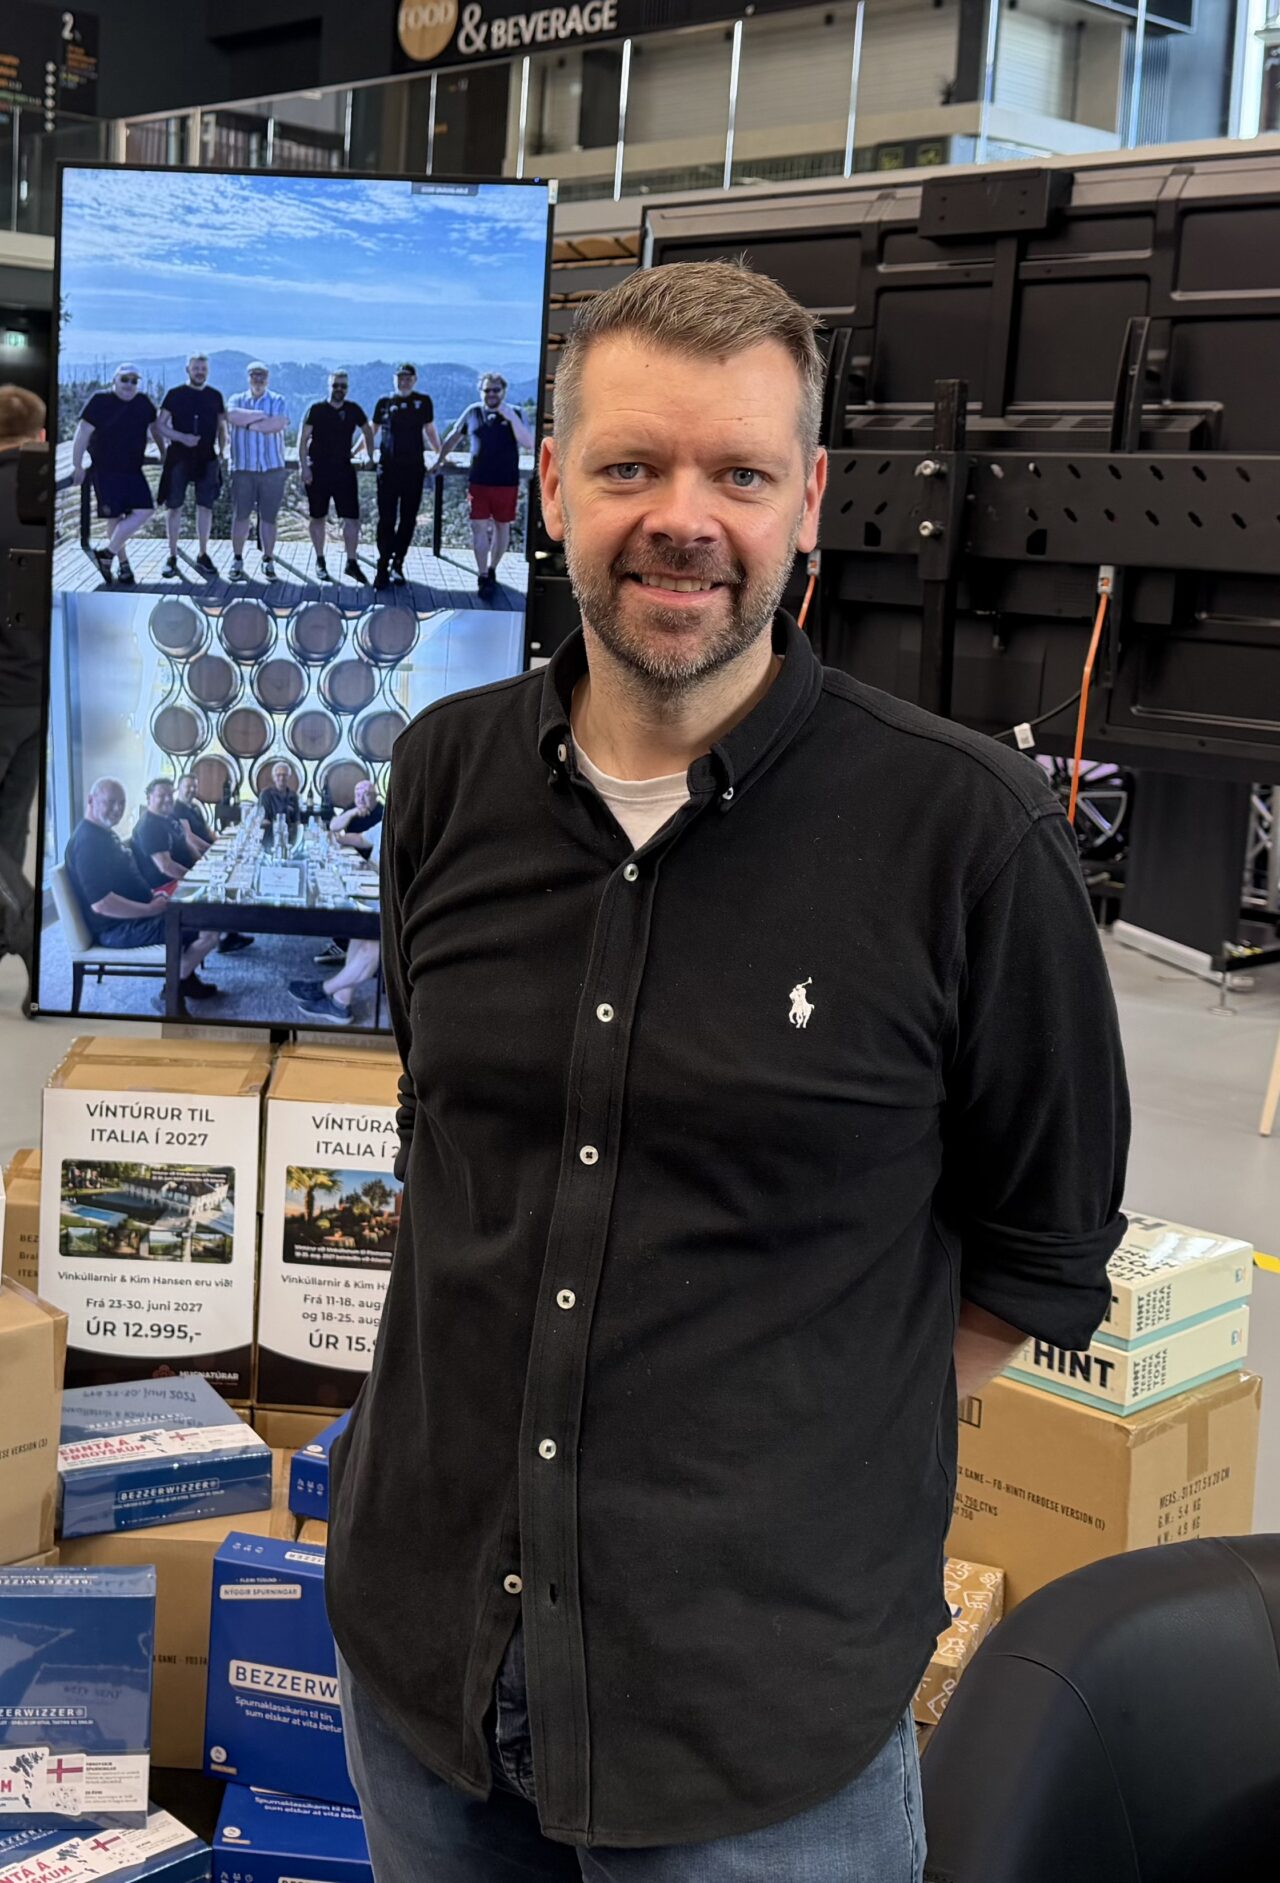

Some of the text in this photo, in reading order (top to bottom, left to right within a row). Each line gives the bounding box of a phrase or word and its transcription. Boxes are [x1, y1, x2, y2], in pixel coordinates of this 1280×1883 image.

[61, 12, 75, 41] 2
[457, 3, 488, 54] &
[491, 0, 618, 49] BEVERAGE
[86, 1100, 216, 1123] VÍNTÚRUR TIL
[90, 1126, 209, 1147] ITALIA Í 2027
[316, 1140, 387, 1158] ITALIA Í
[120, 1274, 128, 1283] &
[130, 1274, 151, 1284] Kim
[153, 1276, 193, 1286] Hansen
[194, 1279, 212, 1288] eru
[343, 1280, 374, 1290] & Kim
[86, 1297, 203, 1313] Frá 23-30. juni 2027
[304, 1294, 355, 1308] Frá 11-18.
[302, 1311, 355, 1325] og 18-25.
[86, 1315, 202, 1343] ÚR 12.995,-
[309, 1329, 339, 1351] ÚR
[1033, 1338, 1115, 1389] HINT
[1060, 1504, 1093, 1525] VERSION
[235, 1665, 338, 1699] BEZZERW
[245, 1709, 261, 1719] sum
[261, 1710, 291, 1726] elskar
[291, 1716, 301, 1727] at
[302, 1717, 318, 1730] vita
